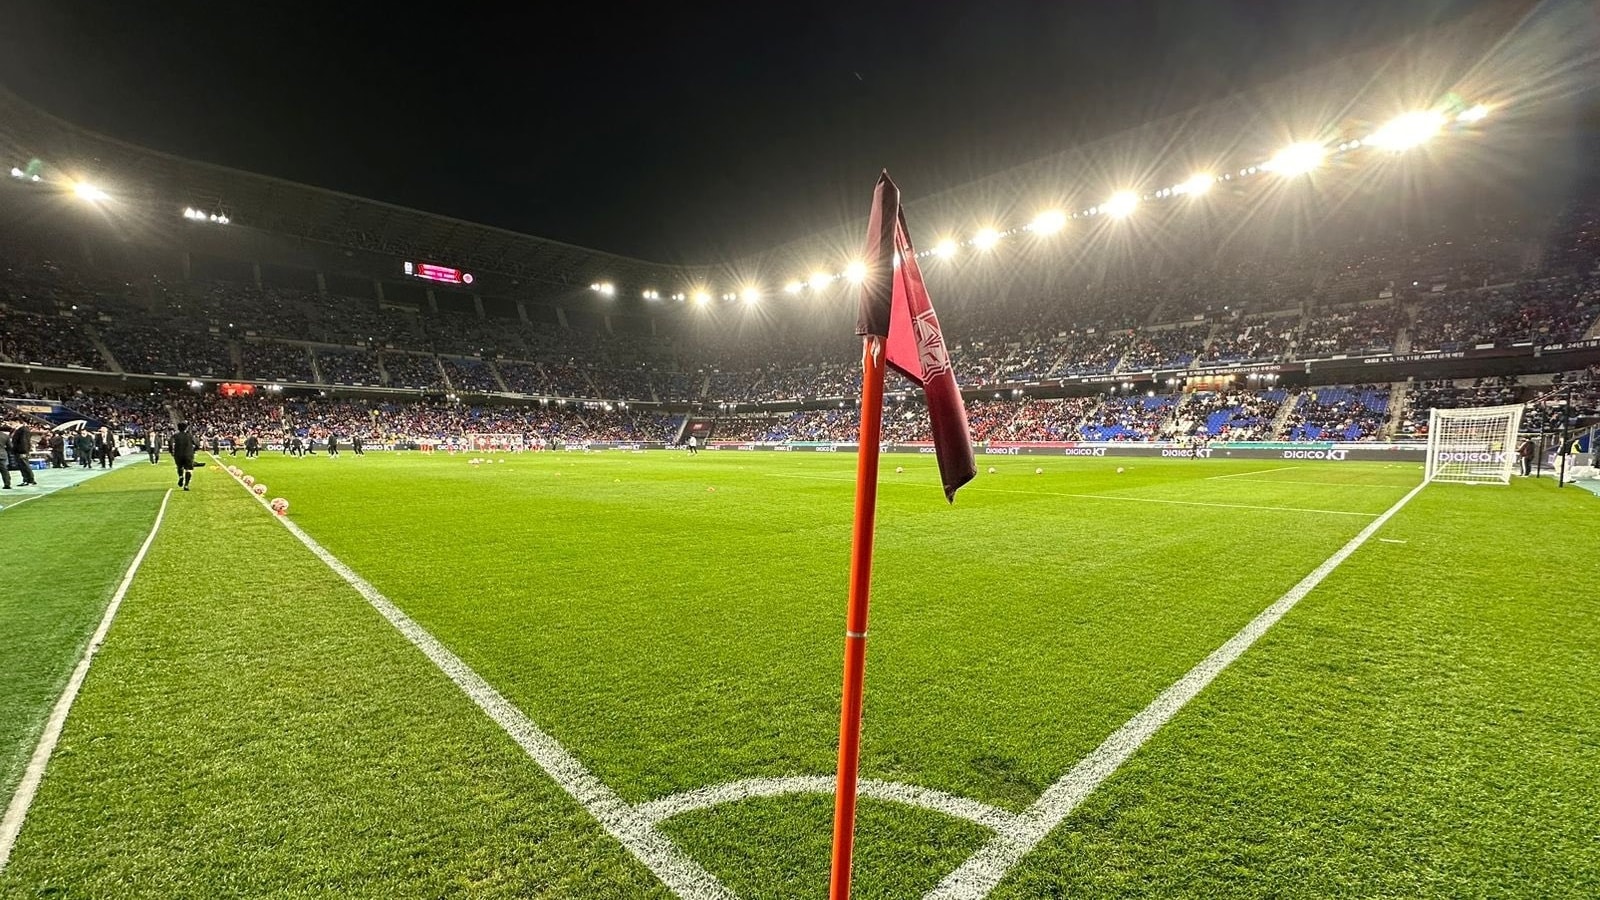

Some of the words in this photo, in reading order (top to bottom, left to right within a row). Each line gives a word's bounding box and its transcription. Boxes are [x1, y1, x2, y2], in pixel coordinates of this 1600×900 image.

[1008, 447, 1020, 455] KT
[1065, 448, 1092, 456] DIGICO
[1092, 447, 1107, 456] KT
[1196, 448, 1213, 458] KT
[1284, 450, 1325, 459] DIGICO
[1325, 449, 1349, 460] KT
[1439, 451, 1491, 462] DIGICO
